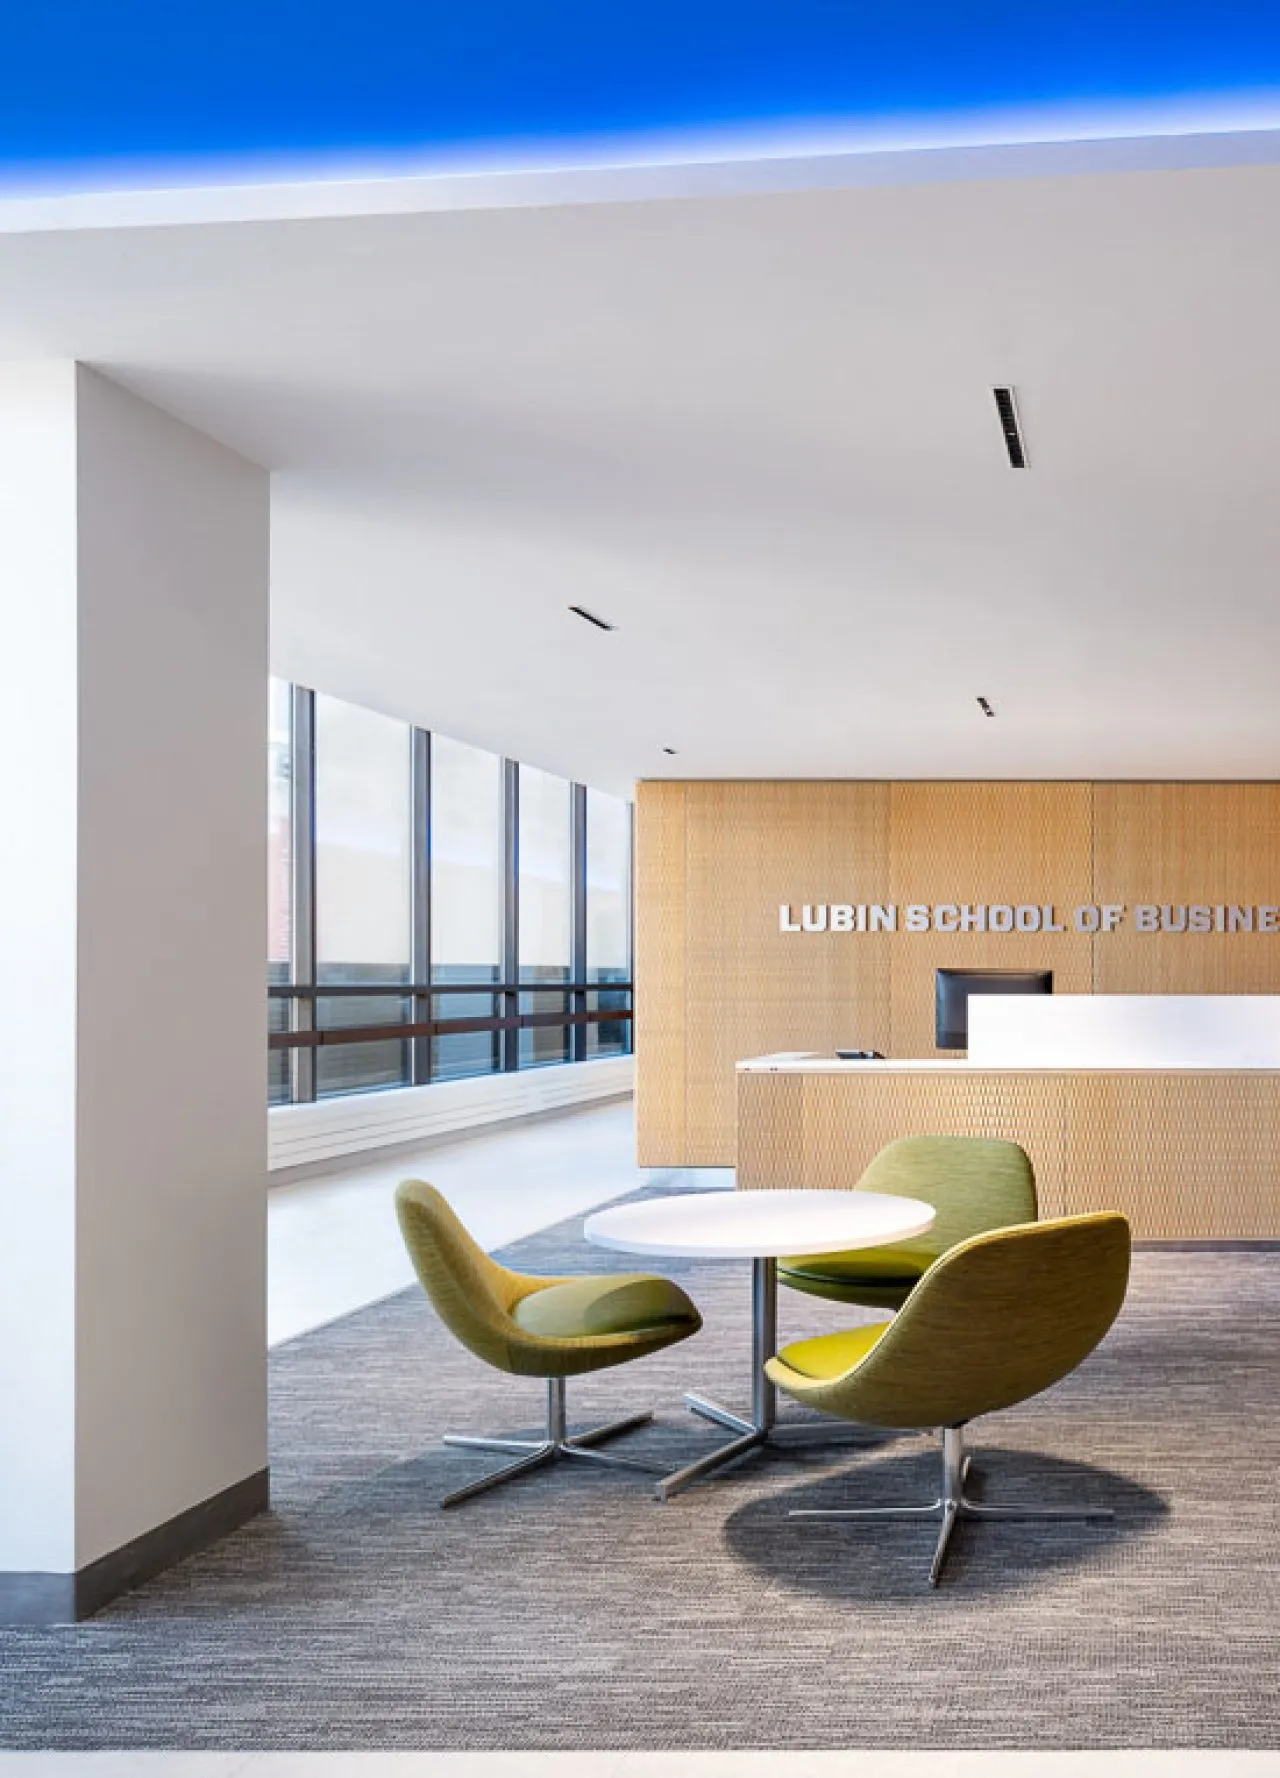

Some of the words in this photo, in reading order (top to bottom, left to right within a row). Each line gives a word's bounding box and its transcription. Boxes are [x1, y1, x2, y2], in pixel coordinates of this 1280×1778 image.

[779, 904, 899, 932] LUBIN
[905, 904, 1066, 932] SCHOOL
[1074, 904, 1128, 933] OF
